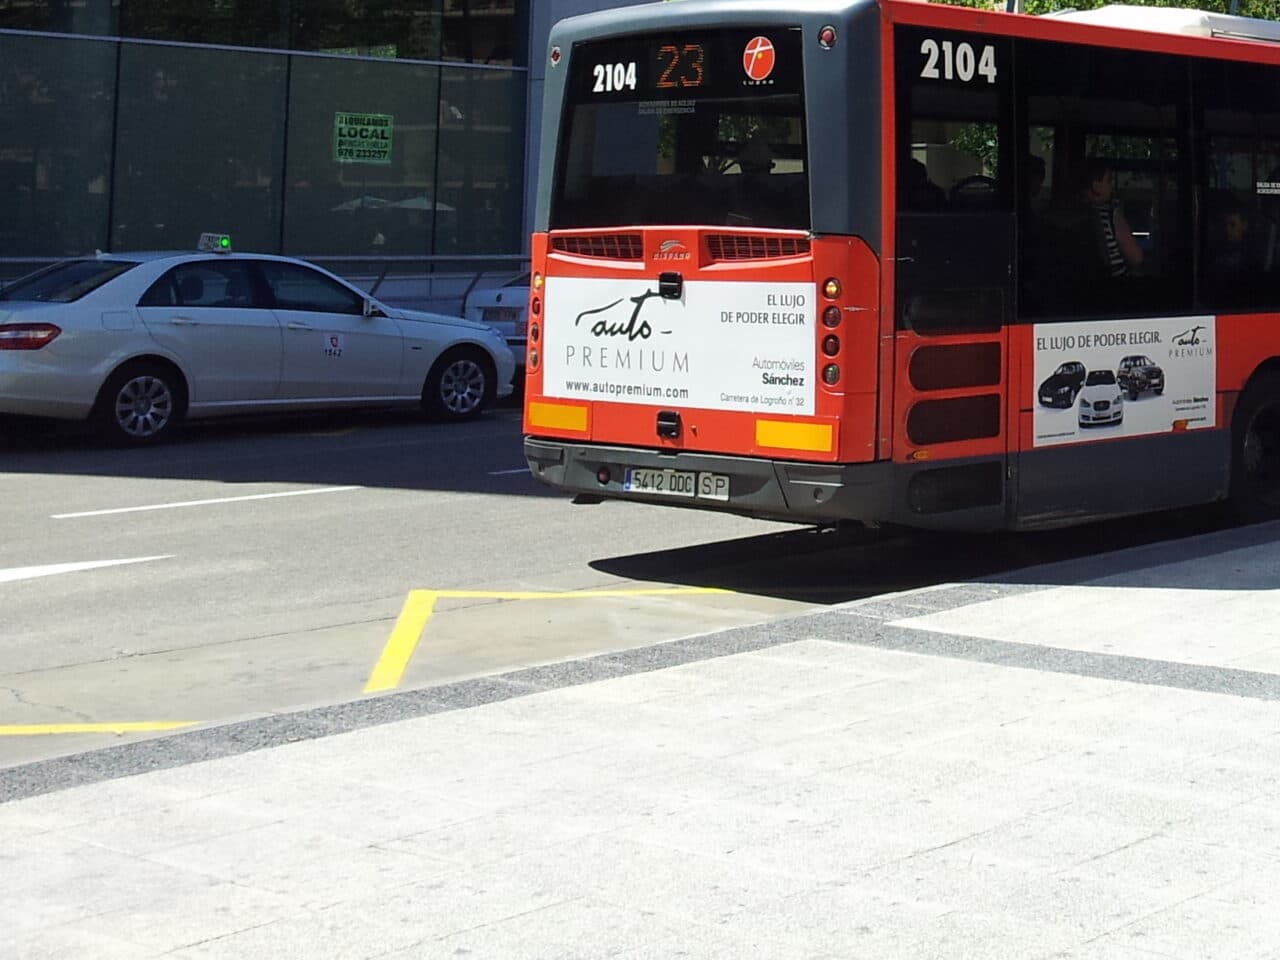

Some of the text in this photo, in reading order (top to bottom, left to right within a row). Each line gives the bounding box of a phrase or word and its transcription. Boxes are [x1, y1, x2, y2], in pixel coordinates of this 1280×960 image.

[656, 44, 704, 87] 23
[919, 39, 997, 83] 2104
[593, 62, 637, 92] 2104
[339, 127, 389, 140] LOCAL
[767, 294, 806, 309] EL LUJO
[590, 288, 652, 341] auto
[720, 311, 805, 326] DE PODER ELEGIR
[1037, 337, 1048, 351] EL
[1050, 335, 1075, 352] LUJO
[1078, 334, 1091, 348] DE
[1094, 332, 1127, 347] PODER
[566, 345, 689, 374] PREMIUM
[1169, 347, 1213, 358] PREMIUM
[752, 356, 805, 371] Automóviles
[762, 372, 805, 387] Sánchez
[566, 380, 689, 399] www.autopremium.com
[720, 392, 749, 404] Carretera
[751, 394, 759, 404] de
[760, 395, 786, 407] Logroño
[634, 471, 726, 496] 5412 DDC SP
